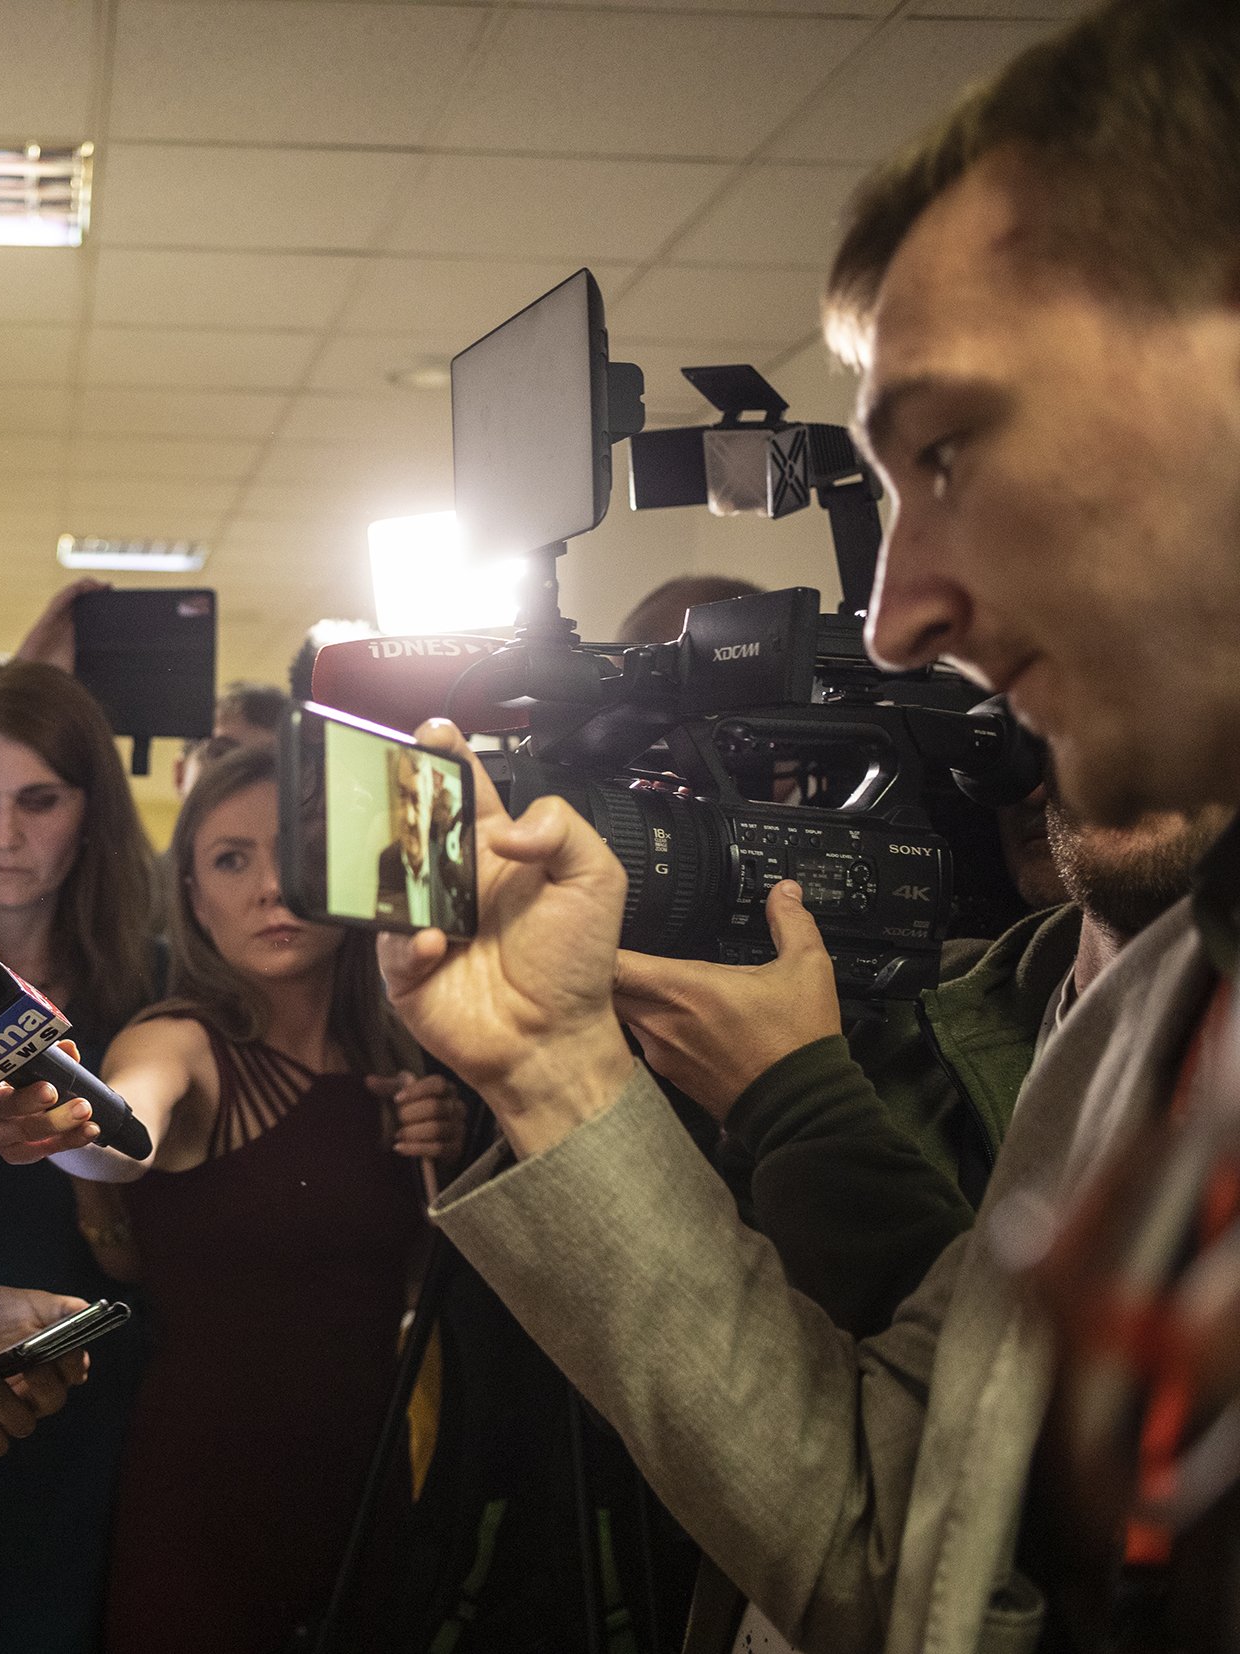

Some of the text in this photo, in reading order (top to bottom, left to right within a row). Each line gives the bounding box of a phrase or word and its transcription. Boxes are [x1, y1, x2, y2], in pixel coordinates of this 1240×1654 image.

[368, 638, 462, 659] iDNES
[713, 641, 760, 662] XDCAM
[889, 844, 933, 857] SONY
[655, 863, 669, 875] G
[891, 884, 931, 902] 4K
